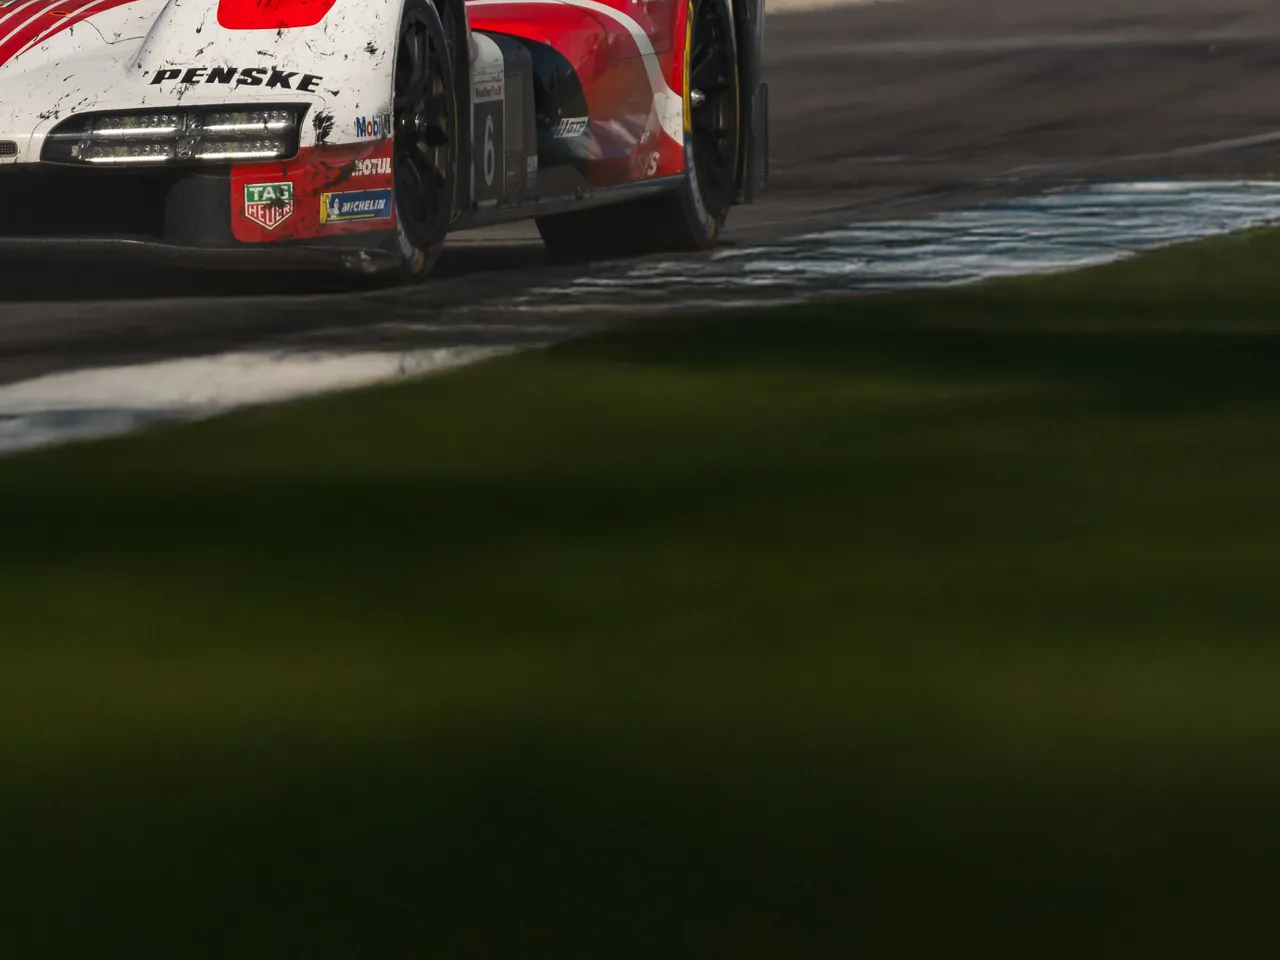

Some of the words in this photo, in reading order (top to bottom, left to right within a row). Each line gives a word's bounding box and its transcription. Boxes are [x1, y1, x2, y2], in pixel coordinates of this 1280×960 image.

[148, 67, 324, 93] PENSKE
[566, 120, 586, 134] GTP
[483, 113, 495, 187] 6
[249, 186, 289, 201] TAG
[248, 202, 290, 227] HEUER
[341, 198, 386, 213] MICHELIN
